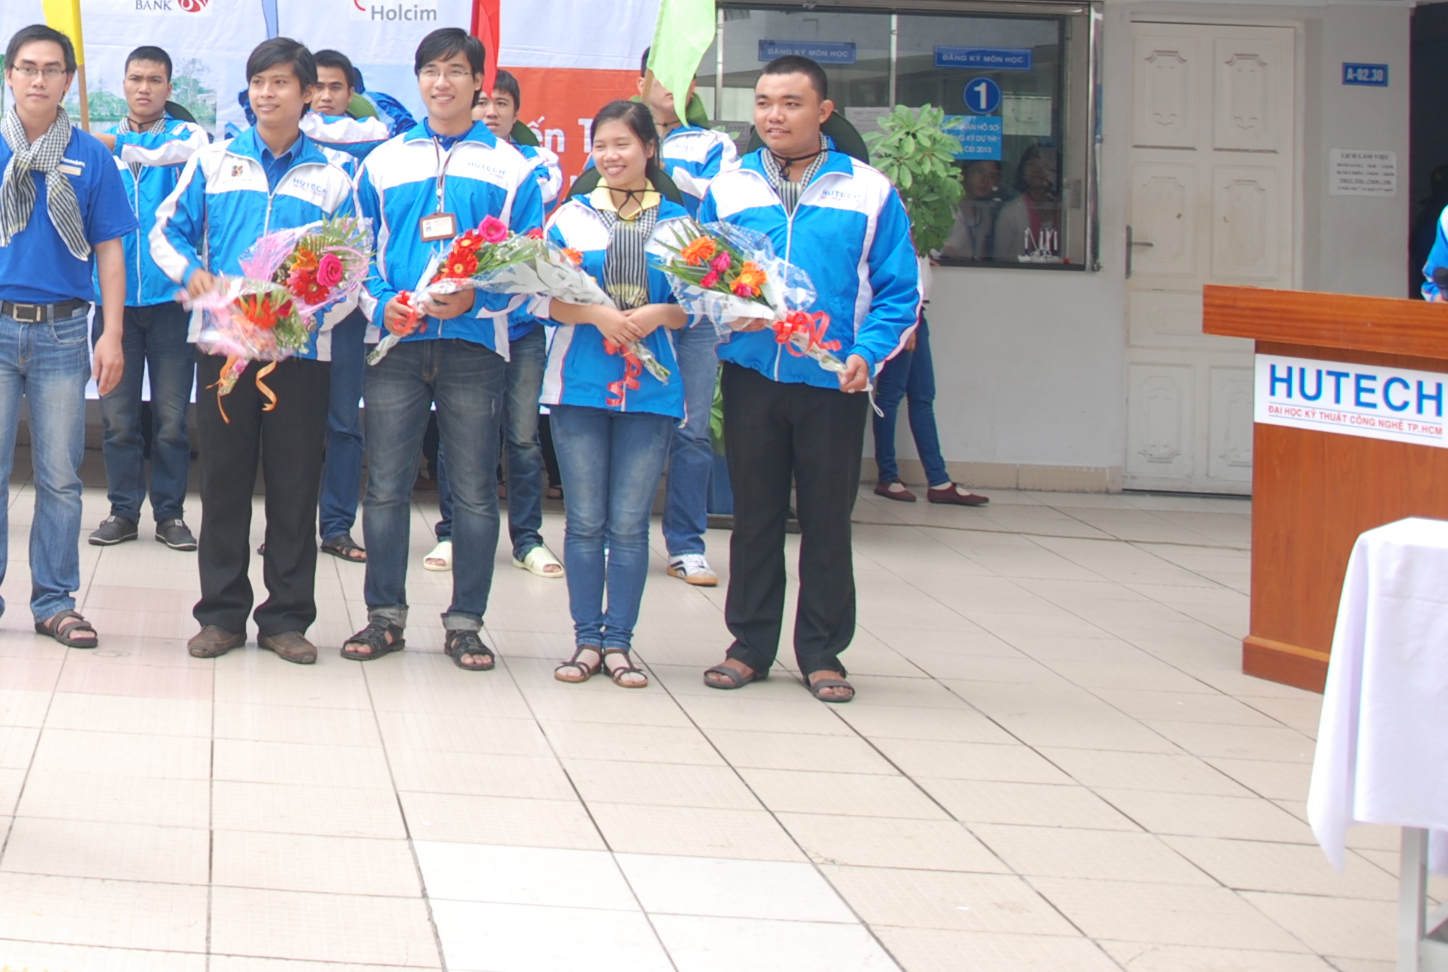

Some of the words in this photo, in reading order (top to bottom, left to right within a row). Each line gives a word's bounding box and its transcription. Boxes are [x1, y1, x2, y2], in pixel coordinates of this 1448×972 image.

[135, 0, 173, 11] BANK
[370, 5, 438, 22] Holcim
[768, 46, 794, 56] ĐĂNG
[795, 47, 807, 56] KÝ
[808, 48, 828, 57] MÔN
[830, 50, 849, 59] HỌC
[942, 52, 967, 63] ĐĂNG
[968, 53, 982, 63] KÝ
[982, 54, 1003, 64] MÔN
[1004, 56, 1024, 66] HỌC
[1346, 67, 1384, 82] A-02.30
[974, 82, 988, 110] 1
[468, 162, 506, 176] HUTECH
[293, 178, 328, 194] HUTECH
[822, 189, 862, 199] HUTECH
[1268, 363, 1444, 418] HUTECH
[1284, 408, 1302, 418] HỌC
[1304, 408, 1316, 418] KỸ
[1349, 414, 1376, 426] CÔNG
[1378, 418, 1404, 431] NGHỆ
[1407, 422, 1443, 436] TP.HCM
